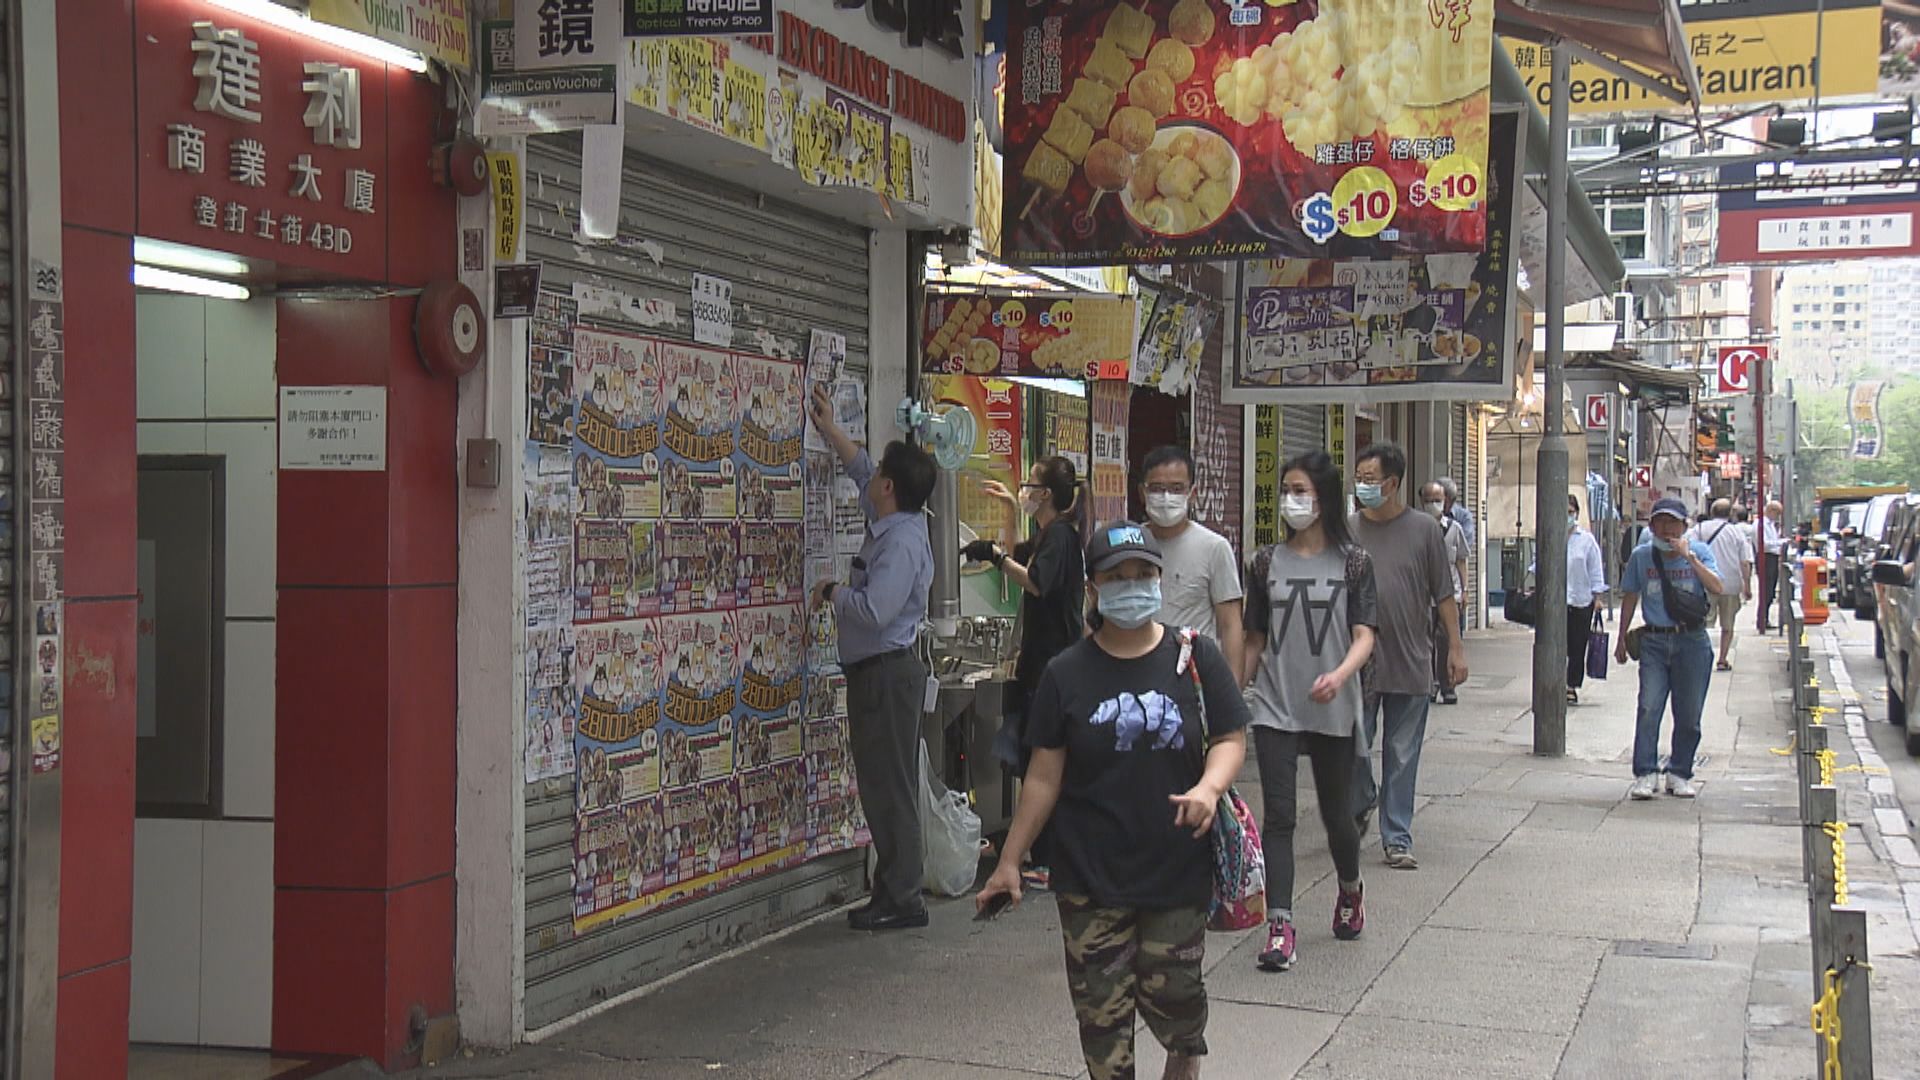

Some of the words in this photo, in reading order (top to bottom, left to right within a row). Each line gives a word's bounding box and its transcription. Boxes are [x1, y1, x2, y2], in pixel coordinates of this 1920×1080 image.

[364, 0, 404, 34] Optical
[406, 6, 441, 51] Trendy
[444, 19, 466, 62] Shop
[636, 18, 681, 30] Optical
[686, 16, 728, 28] Trendy
[732, 15, 762, 27] Shop
[191, 20, 362, 150] 達利
[490, 80, 525, 94] Health
[526, 78, 551, 91] Care
[553, 76, 604, 90] Voucher
[777, 10, 890, 108] EXCHANGE
[891, 68, 966, 143] LIMITED
[167, 123, 376, 214] 商業大廈
[1315, 141, 1375, 165] 雞蛋仔
[1390, 137, 1455, 160] 格仔餅
[1430, 174, 1478, 200] $10
[496, 159, 514, 255] 眼鏡時尚店
[1337, 190, 1390, 226] $10
[1094, 431, 1122, 460] 租/售
